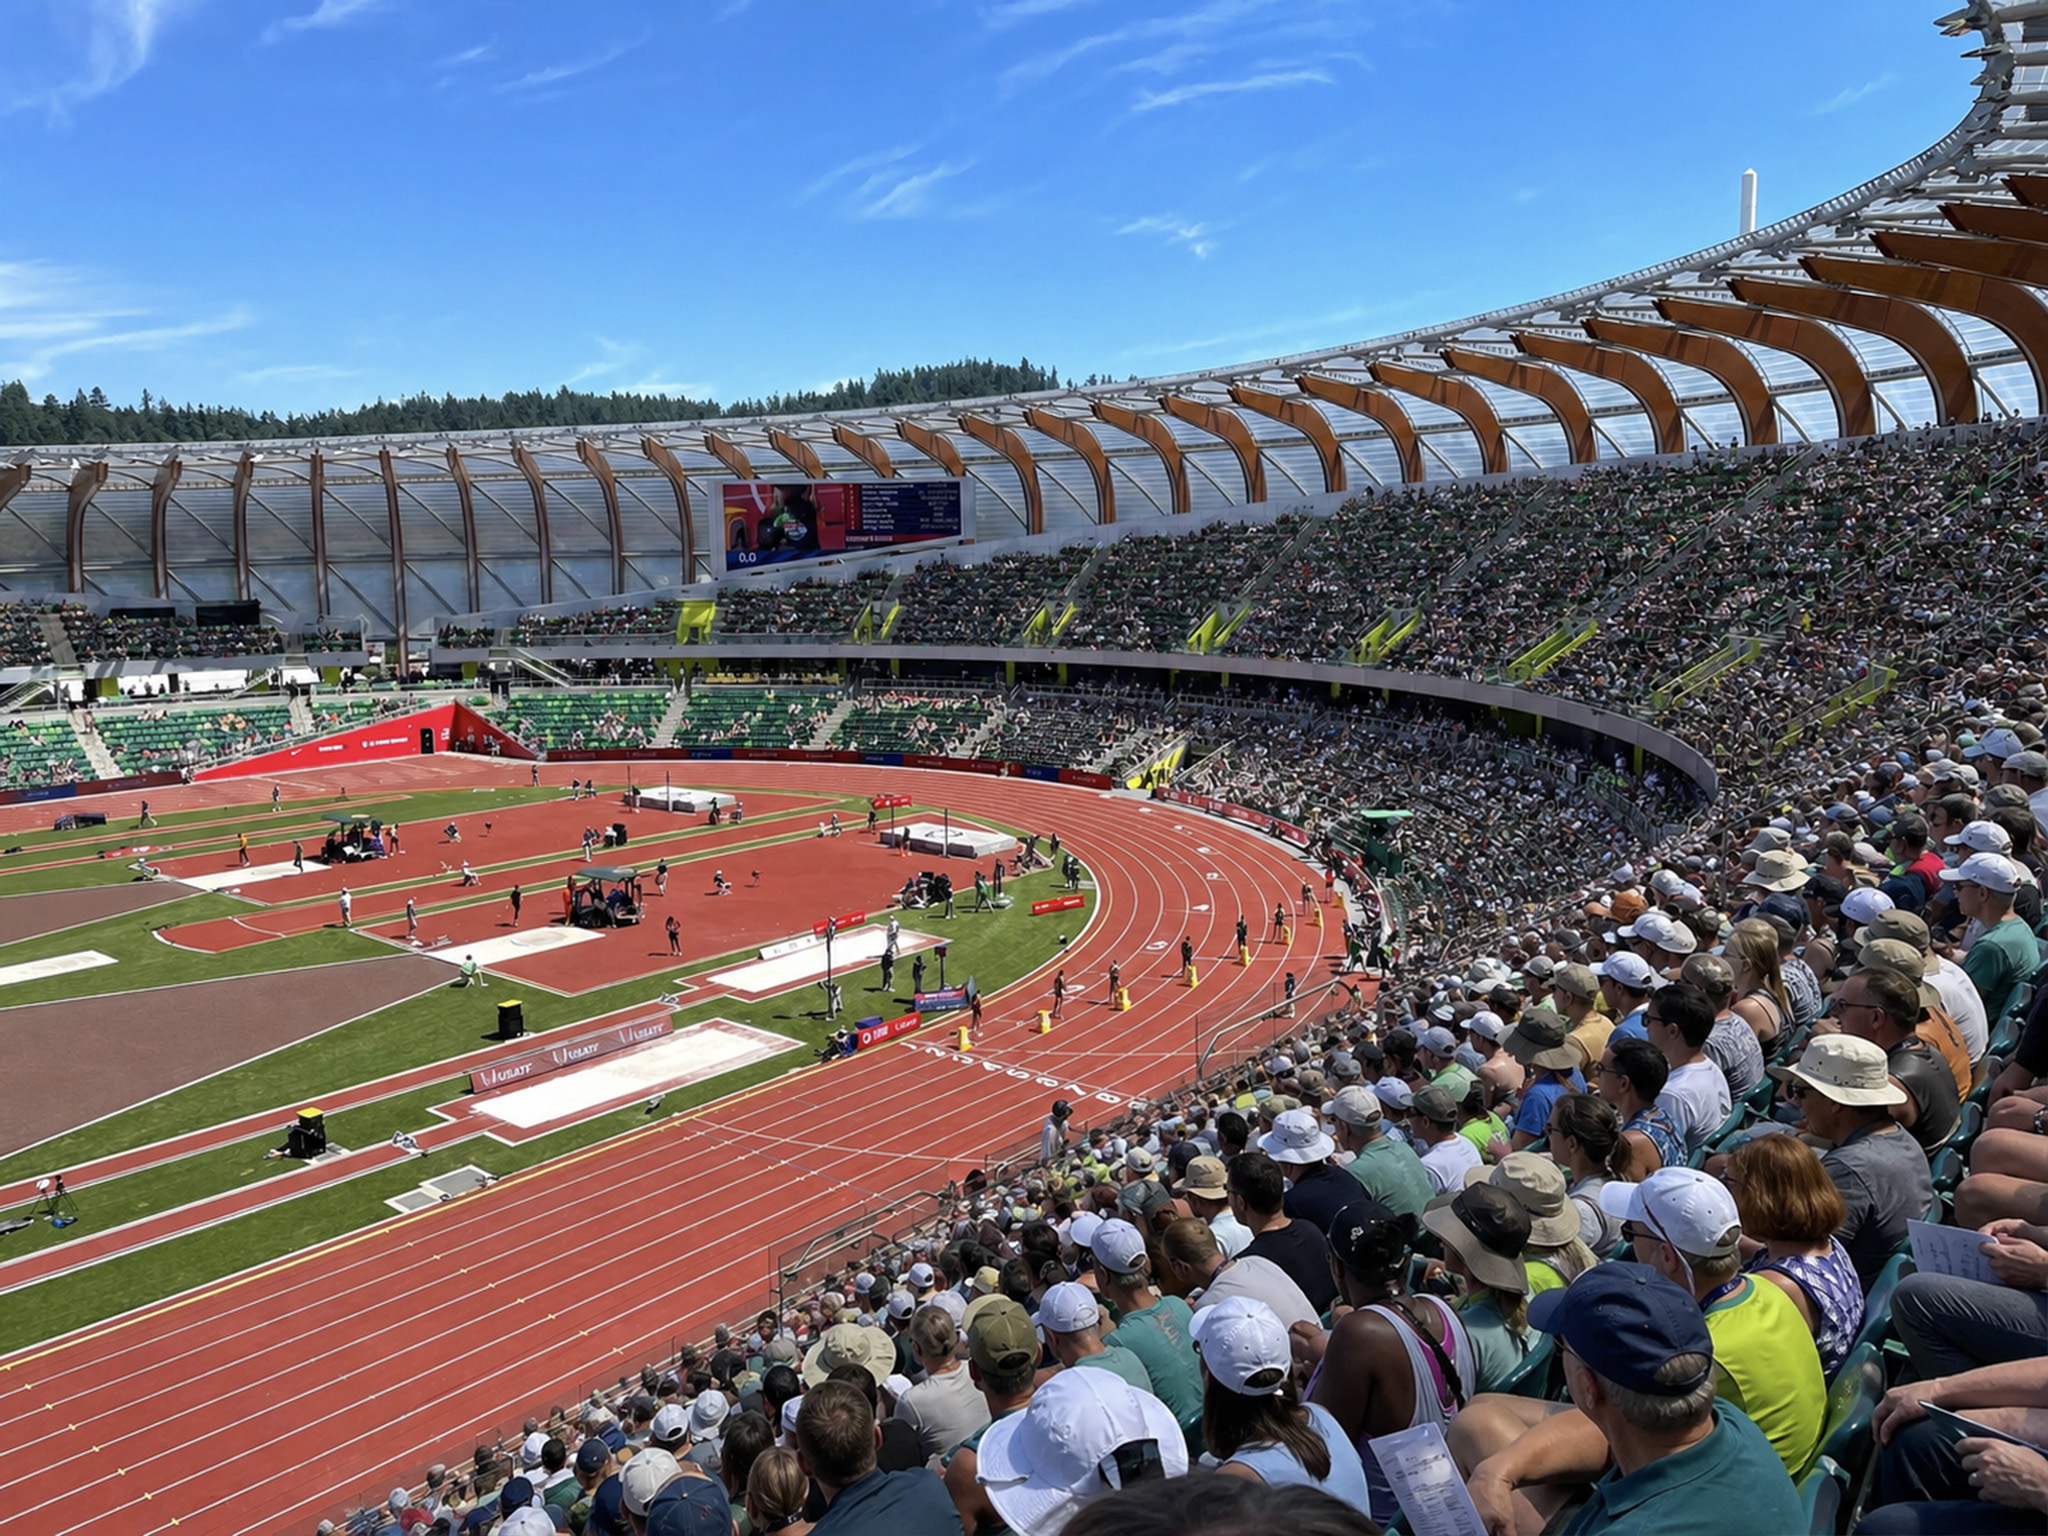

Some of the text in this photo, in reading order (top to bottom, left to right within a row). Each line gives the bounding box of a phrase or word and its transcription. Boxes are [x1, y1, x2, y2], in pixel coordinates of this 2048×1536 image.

[738, 552, 757, 563] 0.0
[899, 1042, 918, 1051] 1
[925, 1046, 946, 1057] 2
[982, 1060, 1003, 1071] 4
[1006, 1068, 1031, 1079] 5
[1063, 1084, 1087, 1096] 7
[1095, 1092, 1122, 1104] 8
